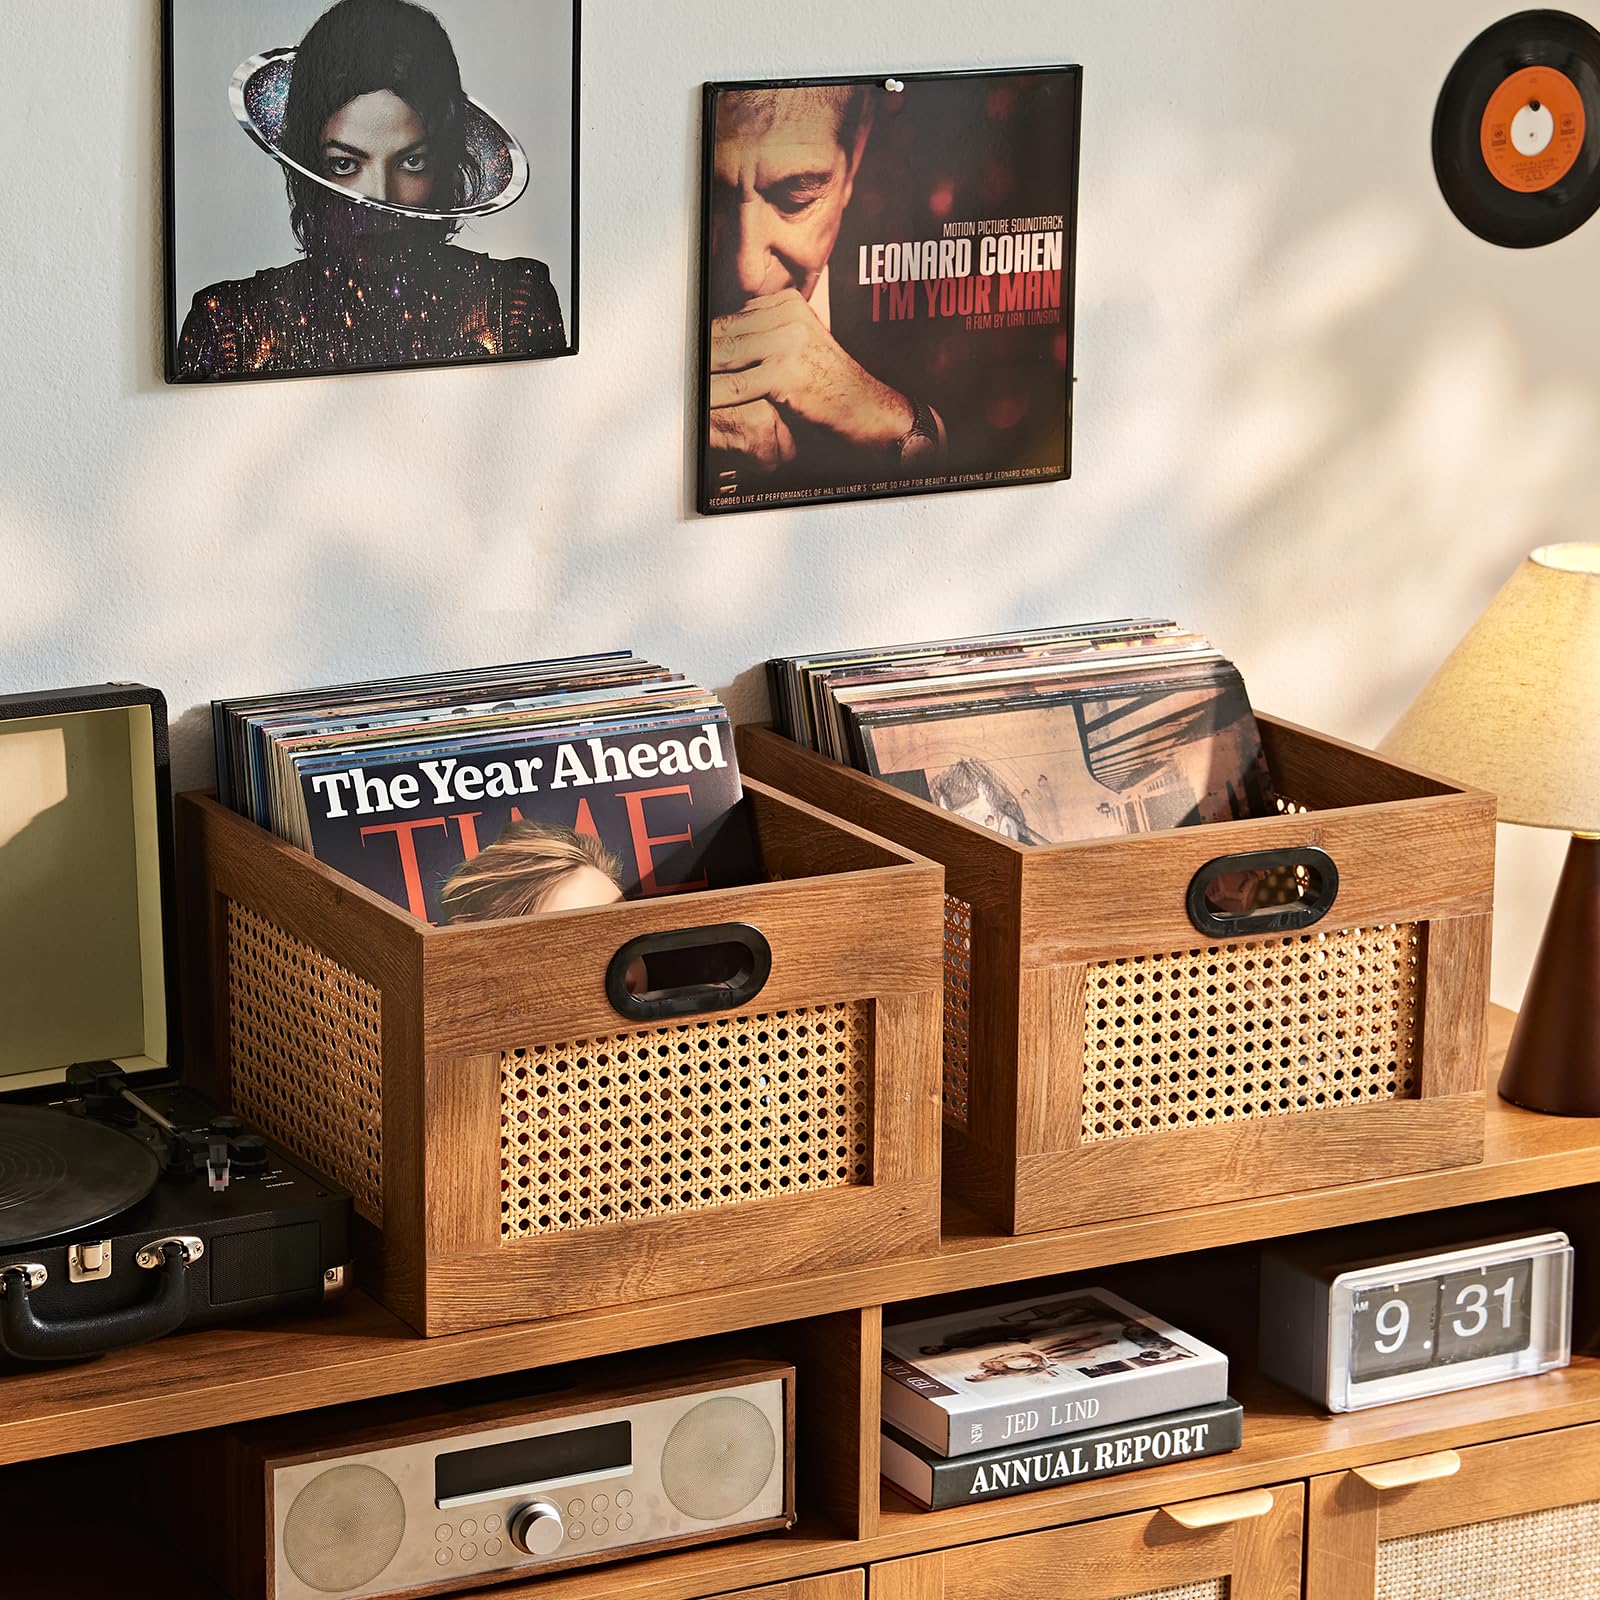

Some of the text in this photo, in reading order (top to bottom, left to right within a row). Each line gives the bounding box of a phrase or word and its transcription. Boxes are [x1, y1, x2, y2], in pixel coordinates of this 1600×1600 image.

[943, 215, 1064, 238] MOTION PICTURE SOUNDTRACK
[858, 231, 1064, 285] LEONARD COHEN
[872, 269, 1062, 322] I'M YOUR MAN
[965, 315, 972, 331] A
[973, 315, 992, 330] FILM
[993, 313, 1005, 329] BY
[1027, 309, 1061, 325] LUNSON
[709, 496, 741, 507] RECORDED
[741, 494, 755, 504] LIVE
[756, 493, 764, 503] AT
[764, 488, 812, 502] PERFORMANCES
[813, 488, 822, 497] OF
[823, 487, 835, 495] HAL
[836, 483, 867, 494] WILLNERS
[889, 480, 898, 490] SO
[899, 479, 911, 488] FAR
[911, 478, 923, 488] FOR
[949, 475, 958, 483] AN
[959, 471, 984, 483] EVENING
[984, 471, 993, 481] OF
[994, 469, 1020, 480] LEONARD
[1021, 467, 1041, 477] COHEN
[312, 724, 728, 819] The Year Ahead
[360, 784, 710, 928] TIE
[971, 1423, 983, 1445] NEW
[1001, 1398, 1100, 1440] JED LIND
[969, 1423, 1209, 1495] ANNUAL REPORT
